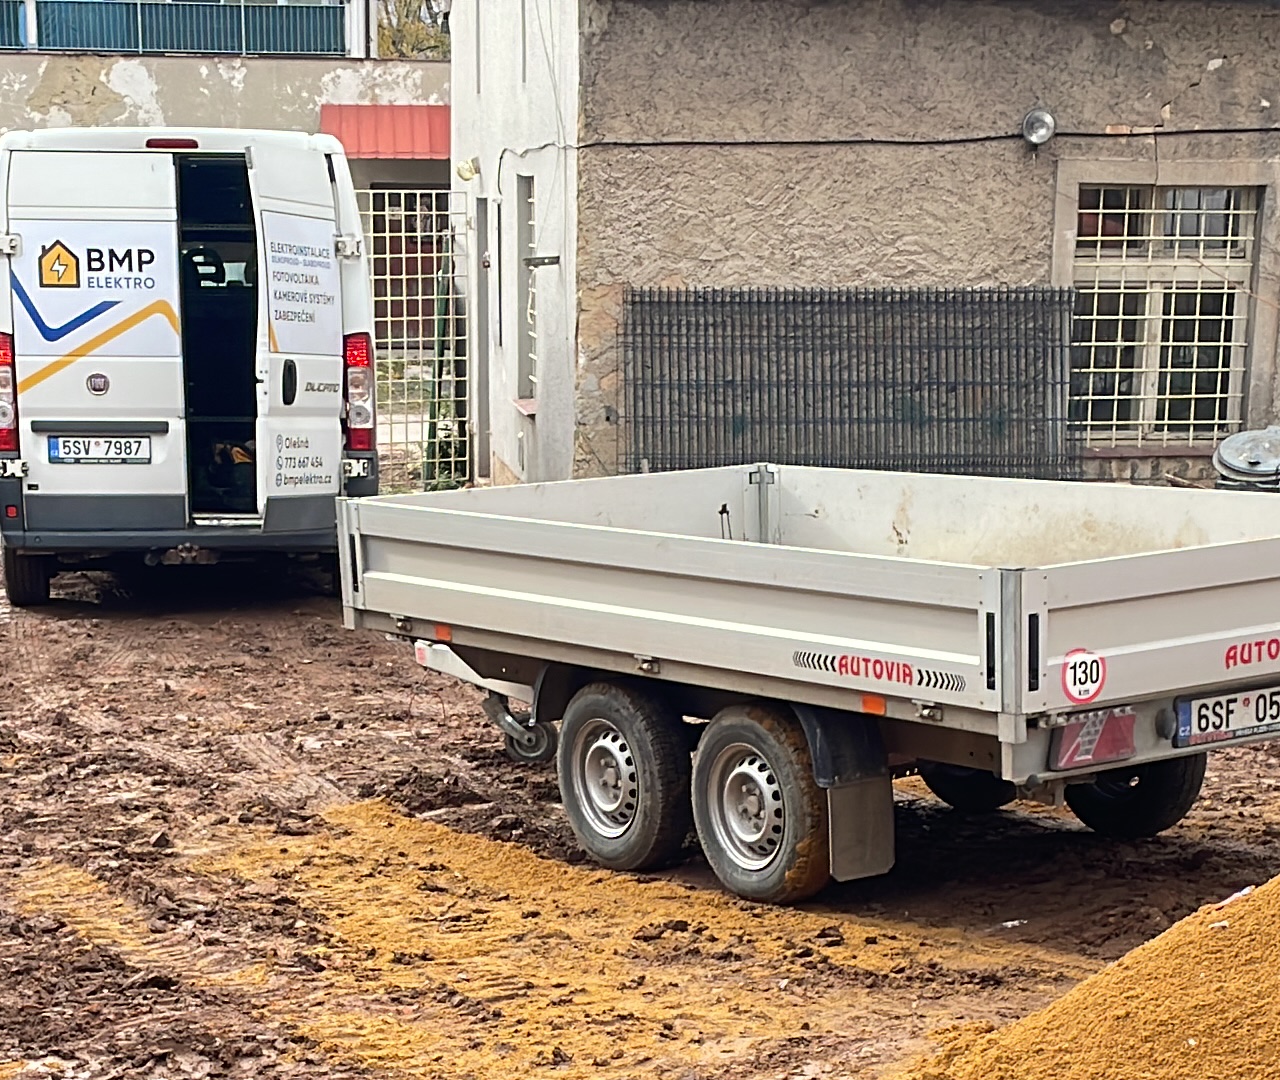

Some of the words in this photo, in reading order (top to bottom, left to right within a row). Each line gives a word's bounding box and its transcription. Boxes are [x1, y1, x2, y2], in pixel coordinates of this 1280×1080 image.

[270, 241, 330, 259] ELEKTROINSTALACE
[86, 248, 155, 272] BMP
[87, 276, 155, 289] ELEKTRO
[62, 440, 91, 456] 5SV
[103, 440, 142, 456] 7987
[284, 457, 297, 469] 773
[283, 473, 332, 488] bmpelektro.cz
[838, 654, 913, 686] AUTOVIA
[1069, 659, 1100, 686] 130
[1197, 697, 1238, 732] 6SF
[1179, 726, 1191, 737] CZ
